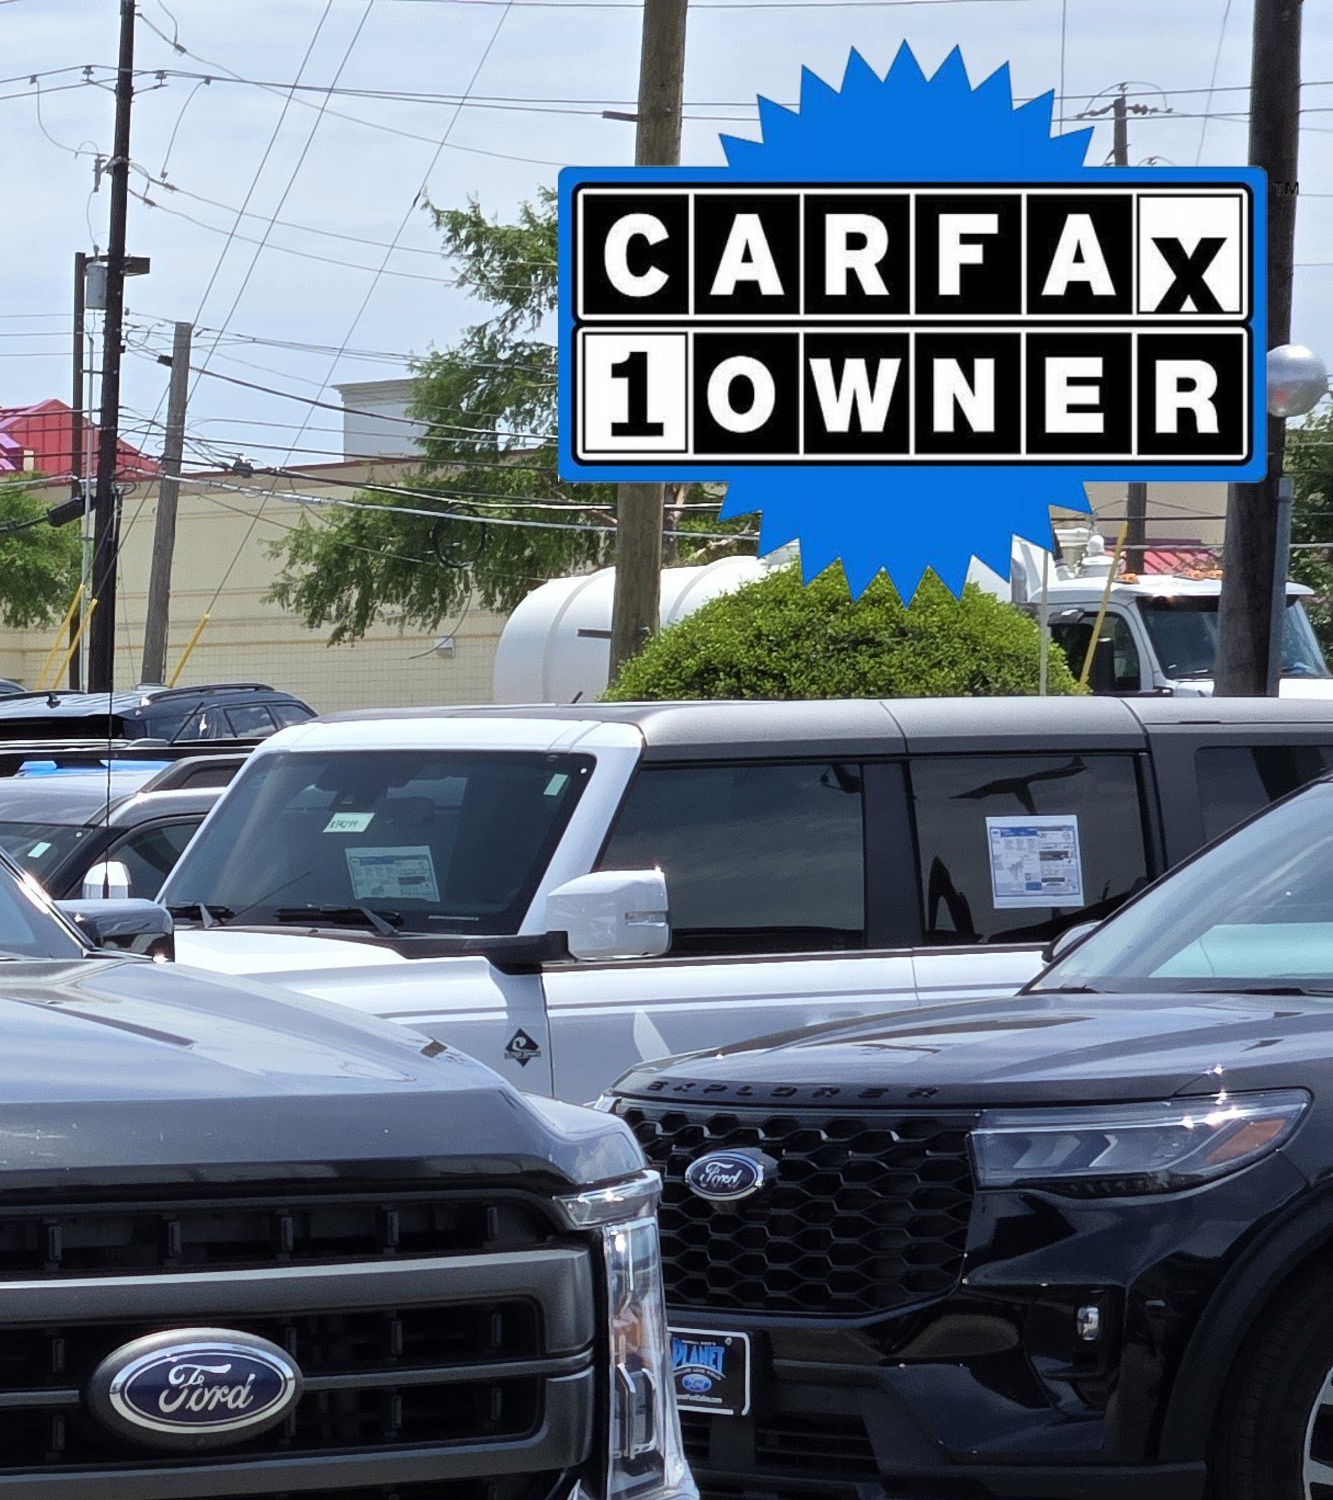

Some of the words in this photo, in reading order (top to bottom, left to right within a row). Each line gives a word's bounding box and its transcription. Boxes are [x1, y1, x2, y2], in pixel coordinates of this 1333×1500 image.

[646, 1080, 940, 1099] EXPLORER
[699, 1162, 743, 1187] Ford
[672, 1337, 724, 1373] PLANET
[159, 1364, 255, 1413] Ford
